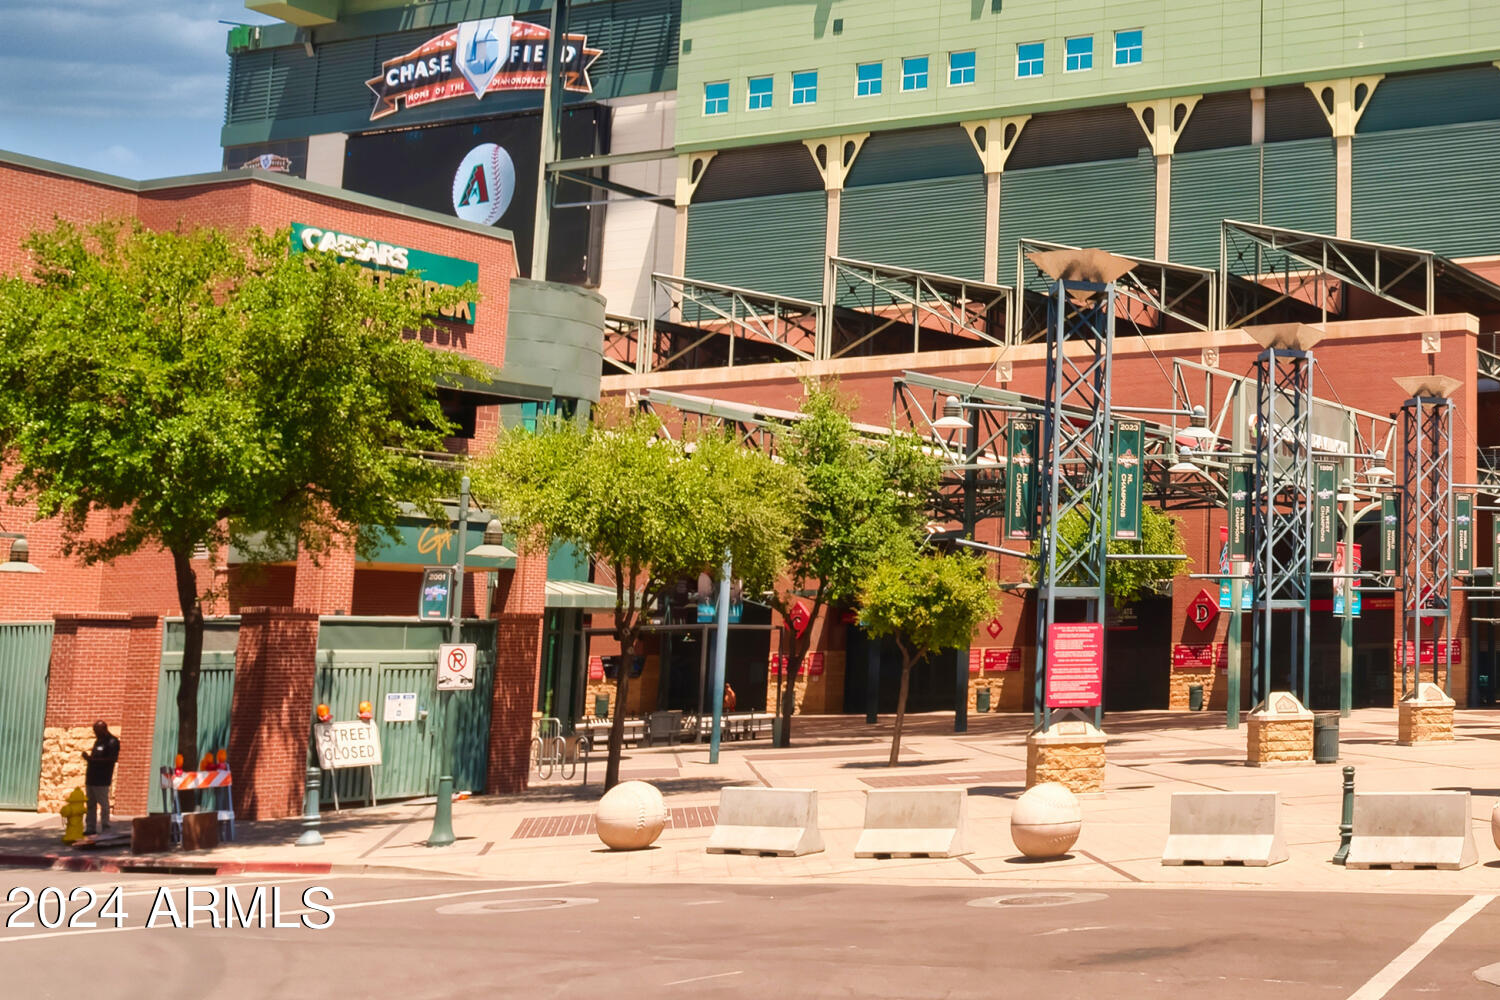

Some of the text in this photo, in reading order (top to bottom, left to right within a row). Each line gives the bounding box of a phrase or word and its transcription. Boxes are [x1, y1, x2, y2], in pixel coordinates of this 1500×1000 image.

[386, 44, 576, 86] CHASE FIED
[408, 90, 429, 102] HOME
[450, 81, 465, 93] THE
[492, 77, 546, 86] DIAMONDBACK
[301, 228, 409, 270] CAESARS
[1120, 423, 1139, 431] 2023
[428, 573, 446, 581] 2001
[1196, 604, 1209, 622] D
[323, 727, 371, 742] STREET
[324, 745, 375, 760] CLOSED
